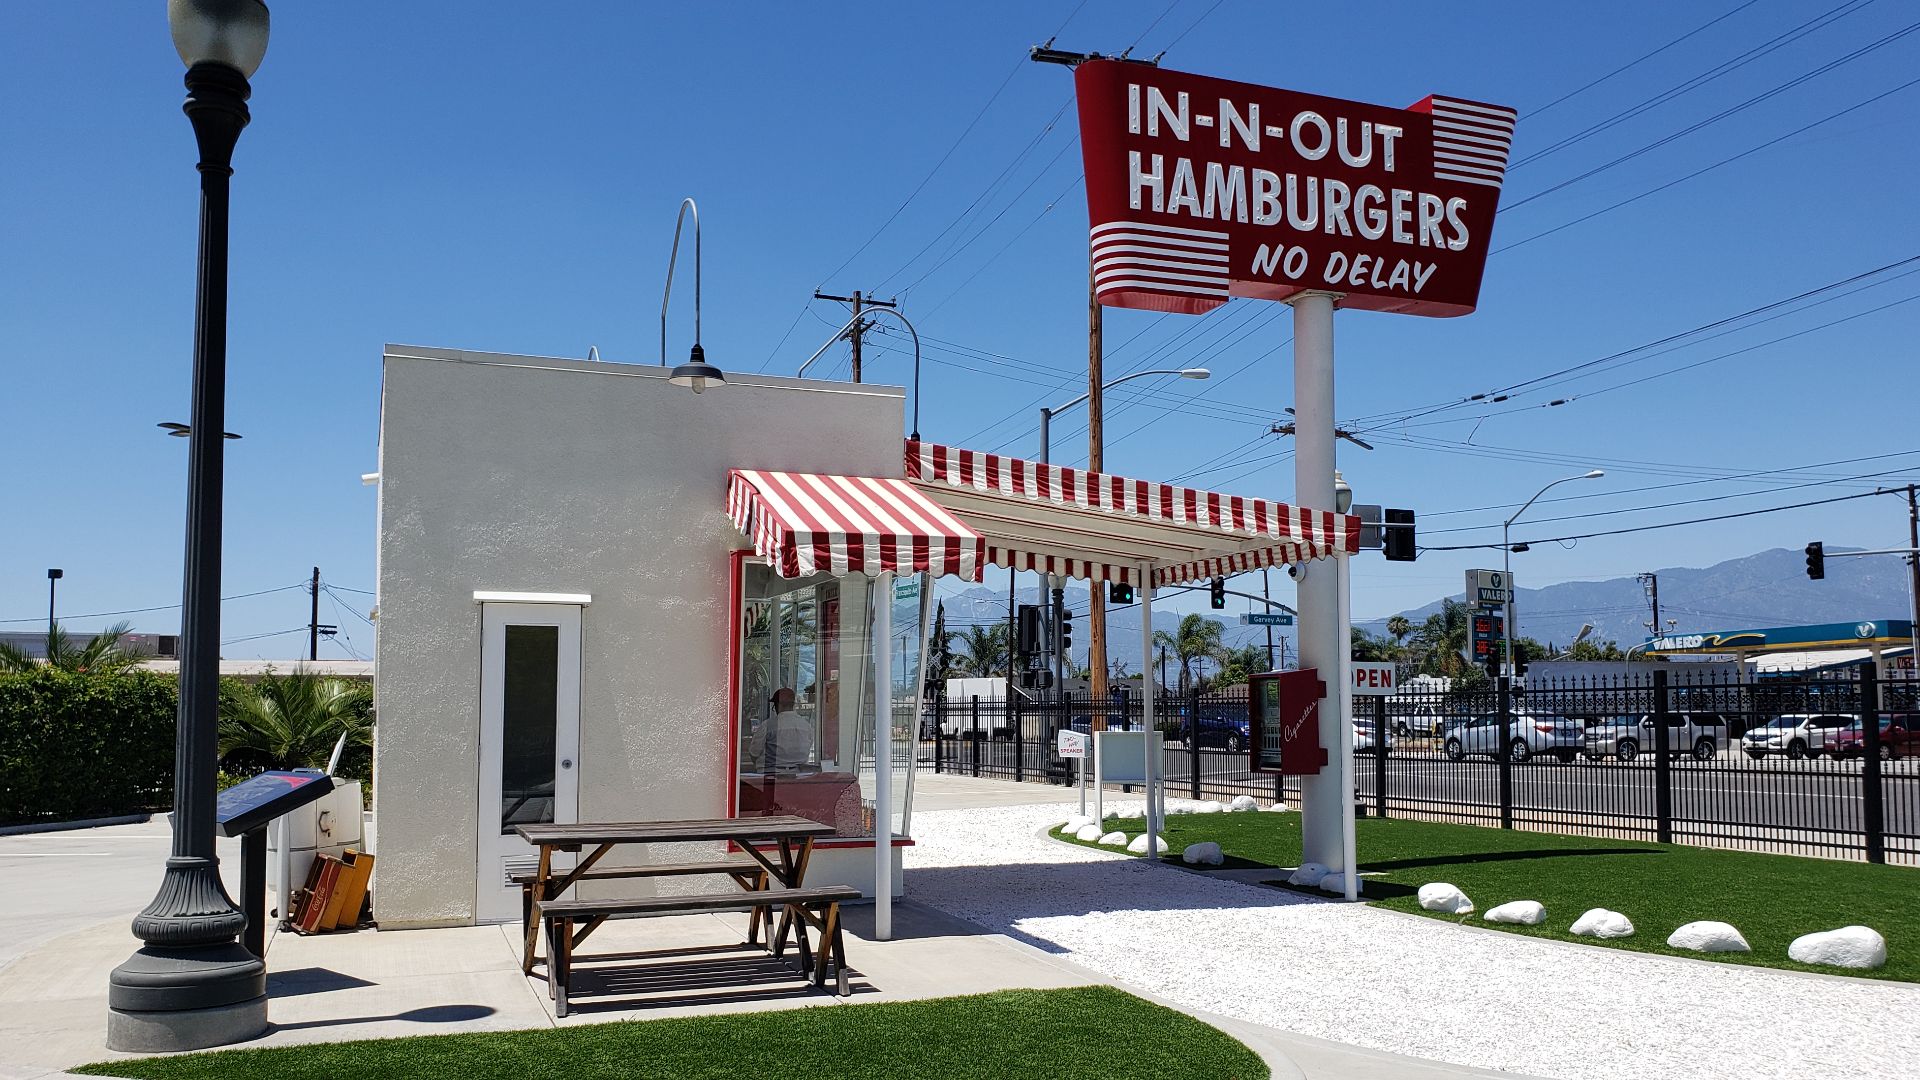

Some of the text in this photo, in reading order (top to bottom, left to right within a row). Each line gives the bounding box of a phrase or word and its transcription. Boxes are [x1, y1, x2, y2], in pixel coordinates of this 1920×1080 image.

[1128, 83, 1403, 173] IN-N-OUT
[1128, 150, 1469, 251] HAMBURGERS
[1251, 243, 1437, 293] NO DELAY
[1653, 635, 1703, 650] VALERO
[1351, 668, 1392, 688] PEN
[1284, 700, 1318, 742] Cigarettes
